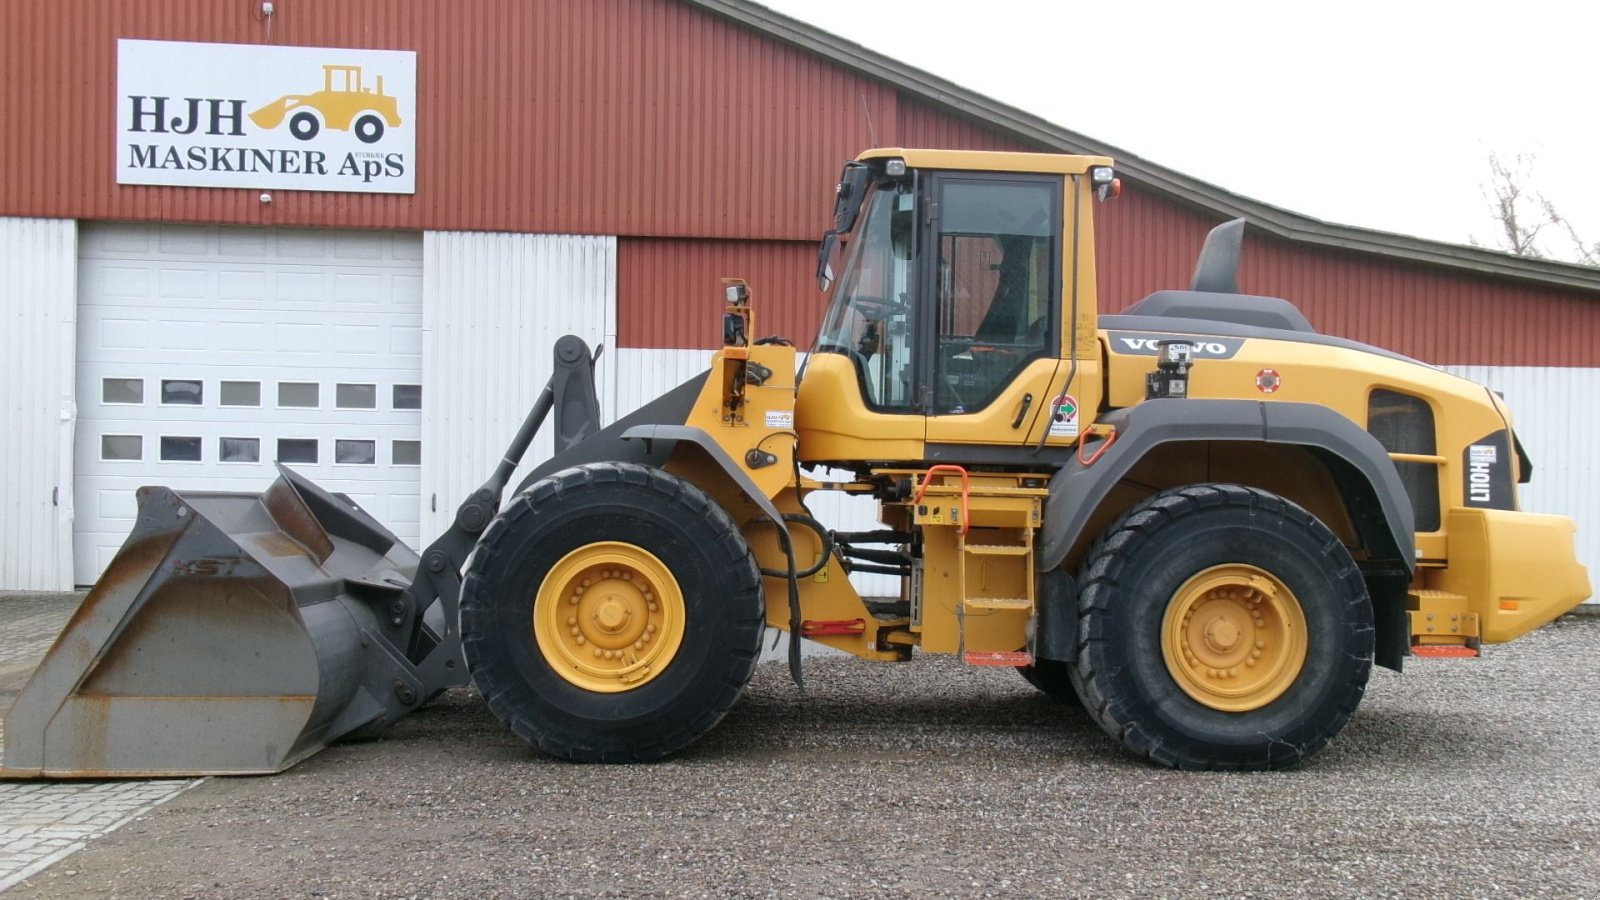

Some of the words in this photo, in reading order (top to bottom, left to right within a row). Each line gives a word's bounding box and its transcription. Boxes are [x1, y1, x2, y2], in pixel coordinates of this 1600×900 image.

[127, 95, 247, 136] HJH
[128, 143, 329, 176] MASKINER
[336, 151, 405, 183] ApS
[1470, 462, 1490, 502] L110H
